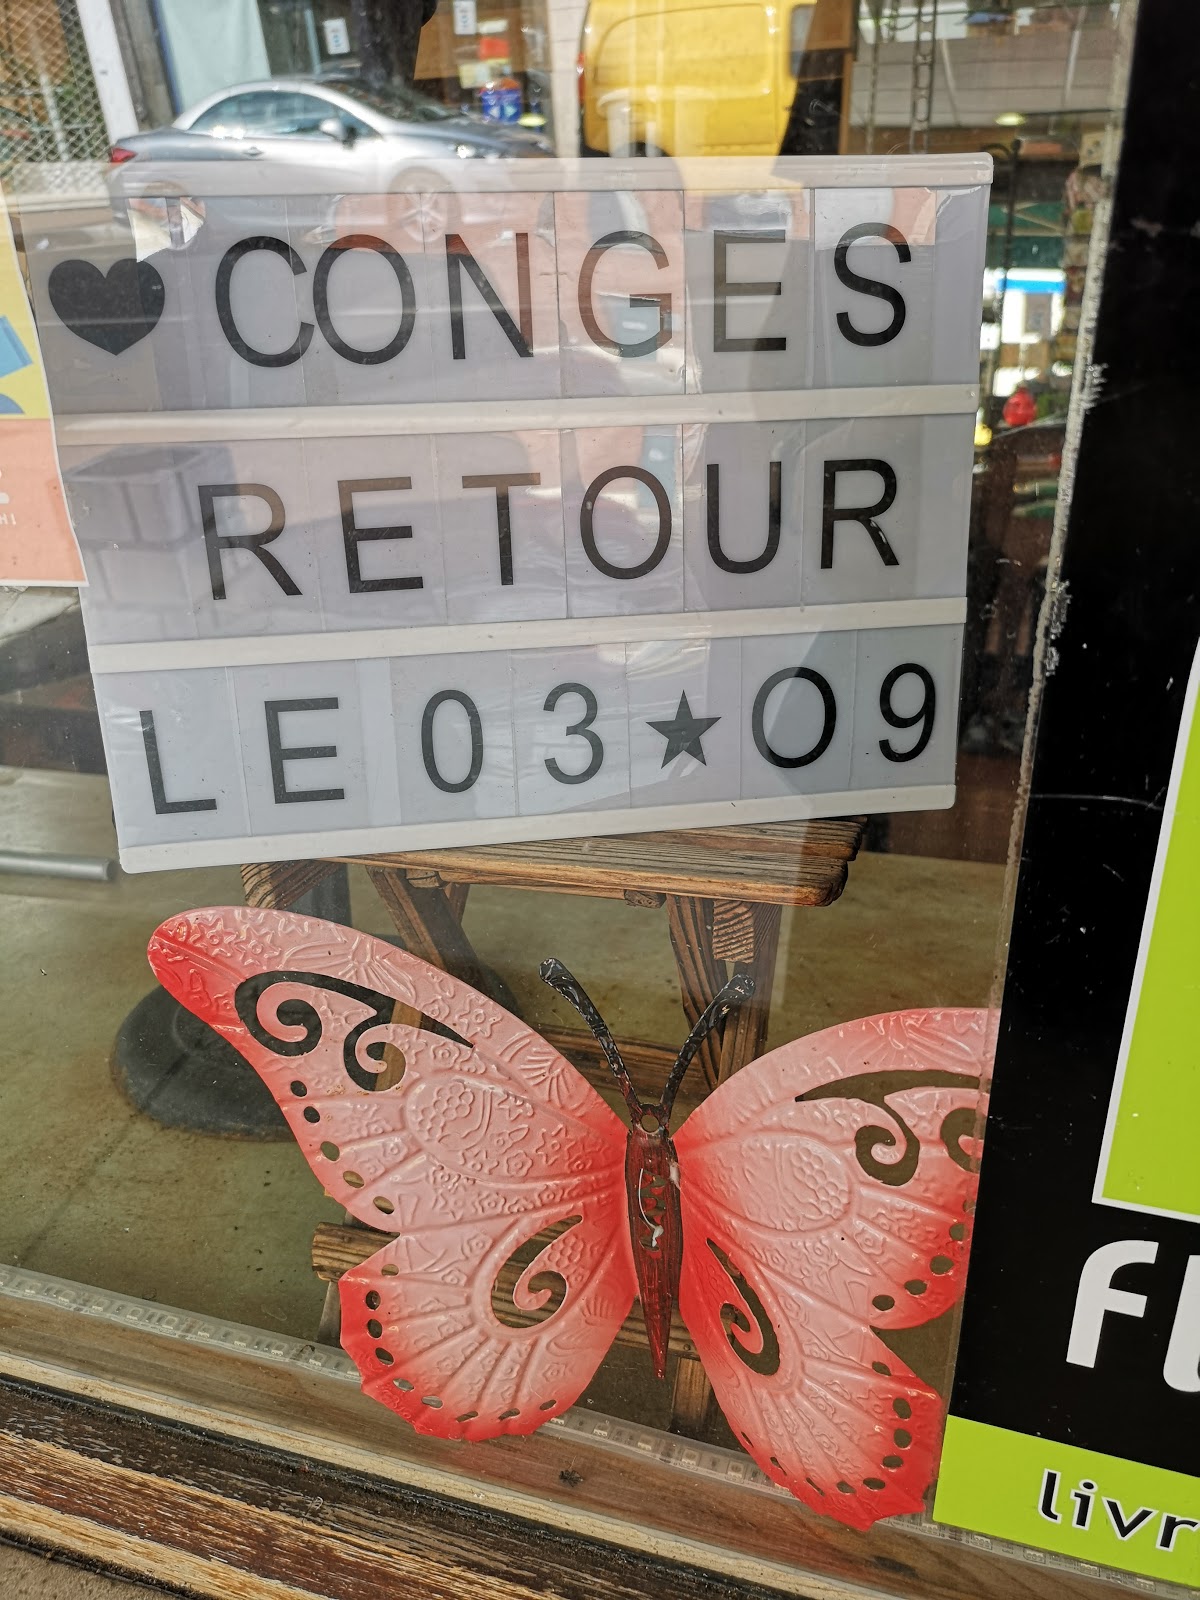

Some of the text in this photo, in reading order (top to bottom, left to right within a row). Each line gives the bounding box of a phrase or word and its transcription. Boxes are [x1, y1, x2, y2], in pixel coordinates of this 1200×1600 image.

[215, 222, 912, 368] CONGES
[197, 458, 900, 600] RETOUR
[139, 696, 345, 816] LE
[1038, 1468, 1200, 1553] livr
